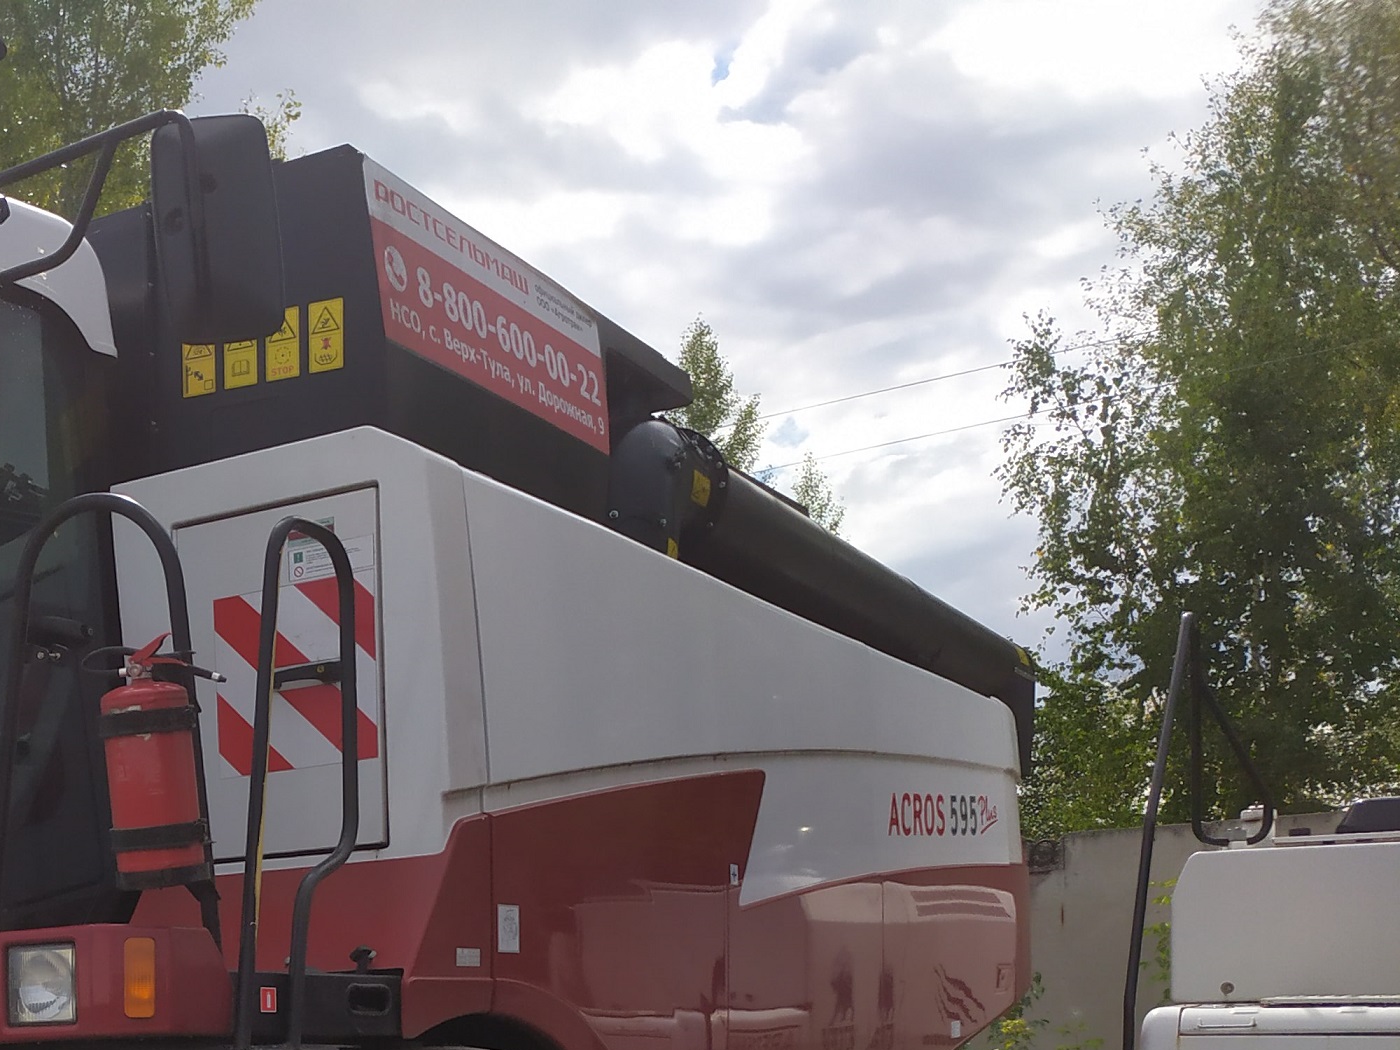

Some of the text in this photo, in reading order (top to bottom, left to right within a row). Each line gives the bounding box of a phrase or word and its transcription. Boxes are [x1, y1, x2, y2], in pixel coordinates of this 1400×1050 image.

[373, 179, 529, 295] РОСТСЕЛЬМАШ
[271, 365, 294, 377] STOP
[390, 298, 605, 436] НСО, с. Верх-Тула, ул. Дорожная, 9
[416, 266, 602, 406] 8-800-600-00-22
[888, 792, 997, 836] ACROS 595 Plus
